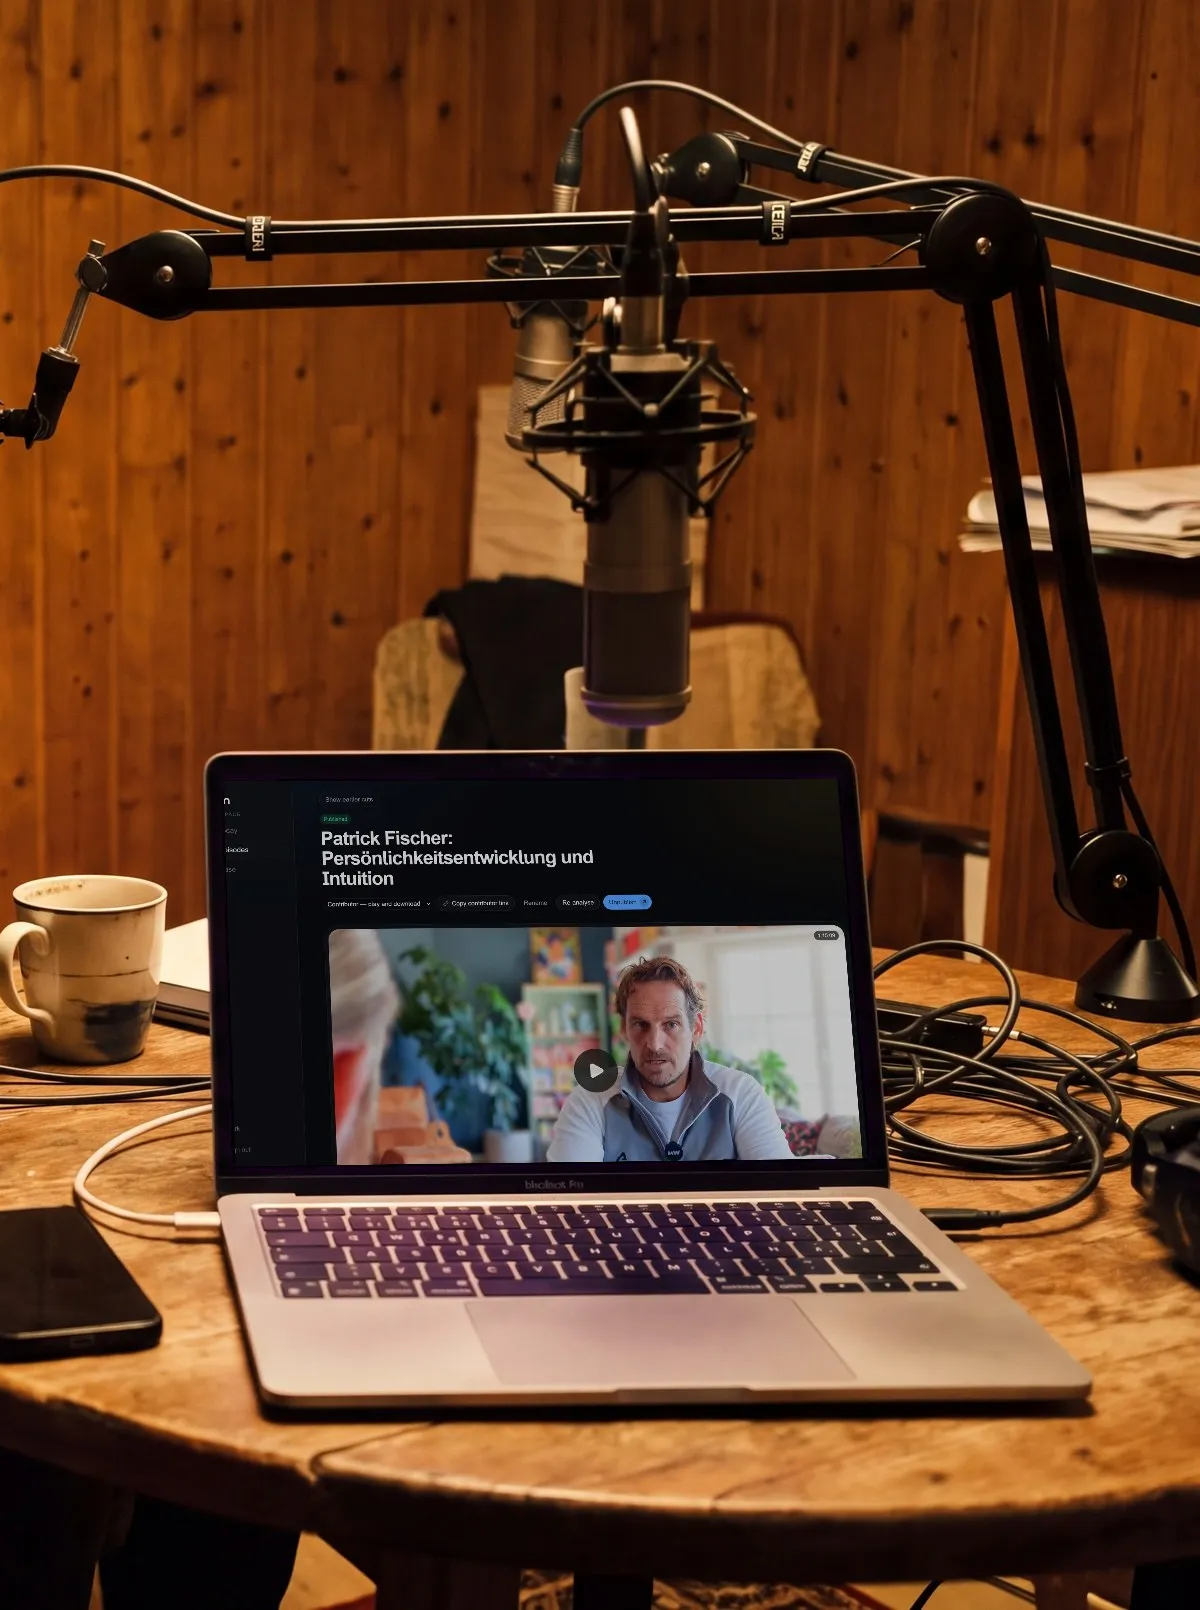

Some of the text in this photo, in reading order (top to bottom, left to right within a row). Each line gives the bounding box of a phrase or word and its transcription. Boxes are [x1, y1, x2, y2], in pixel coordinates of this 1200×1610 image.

[321, 830, 453, 846] Patrick Fischer:
[322, 849, 594, 868] Persönlichkeitsentwicklung und
[322, 870, 395, 886] Intuition
[451, 900, 467, 908] Copy
